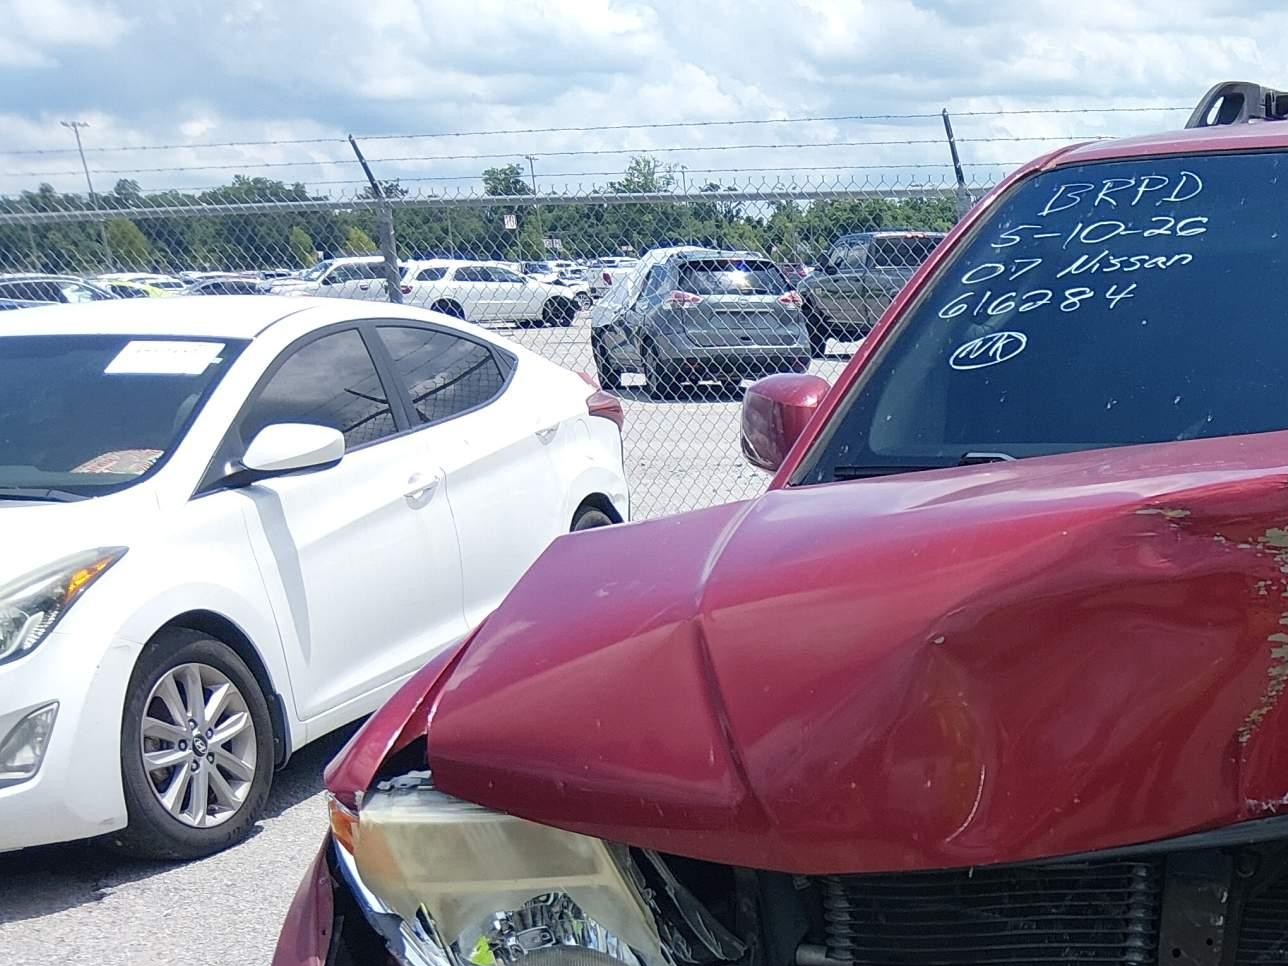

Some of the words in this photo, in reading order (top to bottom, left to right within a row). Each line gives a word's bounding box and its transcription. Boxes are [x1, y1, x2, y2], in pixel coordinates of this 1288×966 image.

[1038, 171, 1203, 217] BRPD
[991, 217, 1209, 250] 5-10-26
[961, 258, 1042, 285] 07
[1056, 250, 1193, 278] Nissan
[938, 284, 1137, 319] 616284
